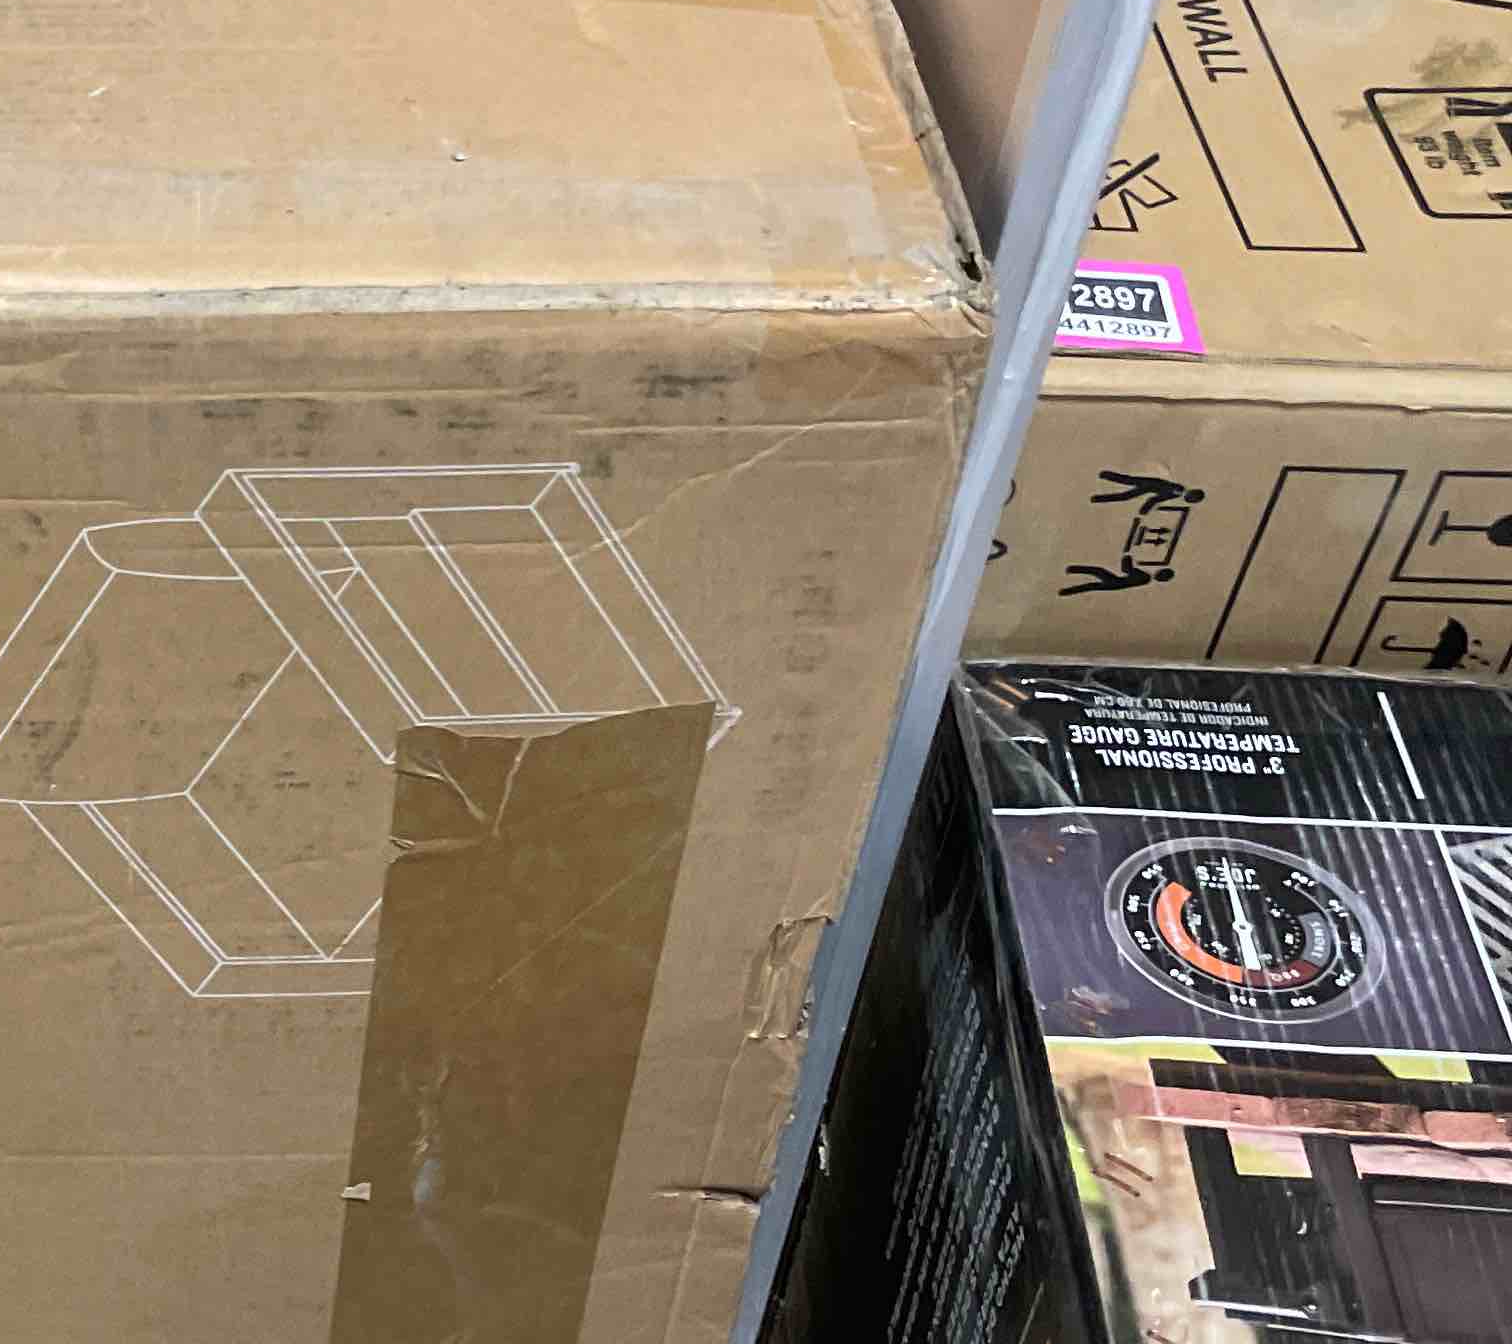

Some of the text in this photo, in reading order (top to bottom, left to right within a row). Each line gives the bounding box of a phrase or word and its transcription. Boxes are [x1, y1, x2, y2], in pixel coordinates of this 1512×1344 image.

[1071, 283, 1155, 312] 2897
[1059, 317, 1171, 339] 4412897
[1070, 724, 1301, 753] TEMPERATURE GAUGE
[1095, 748, 1256, 775] PROFESSIONAL
